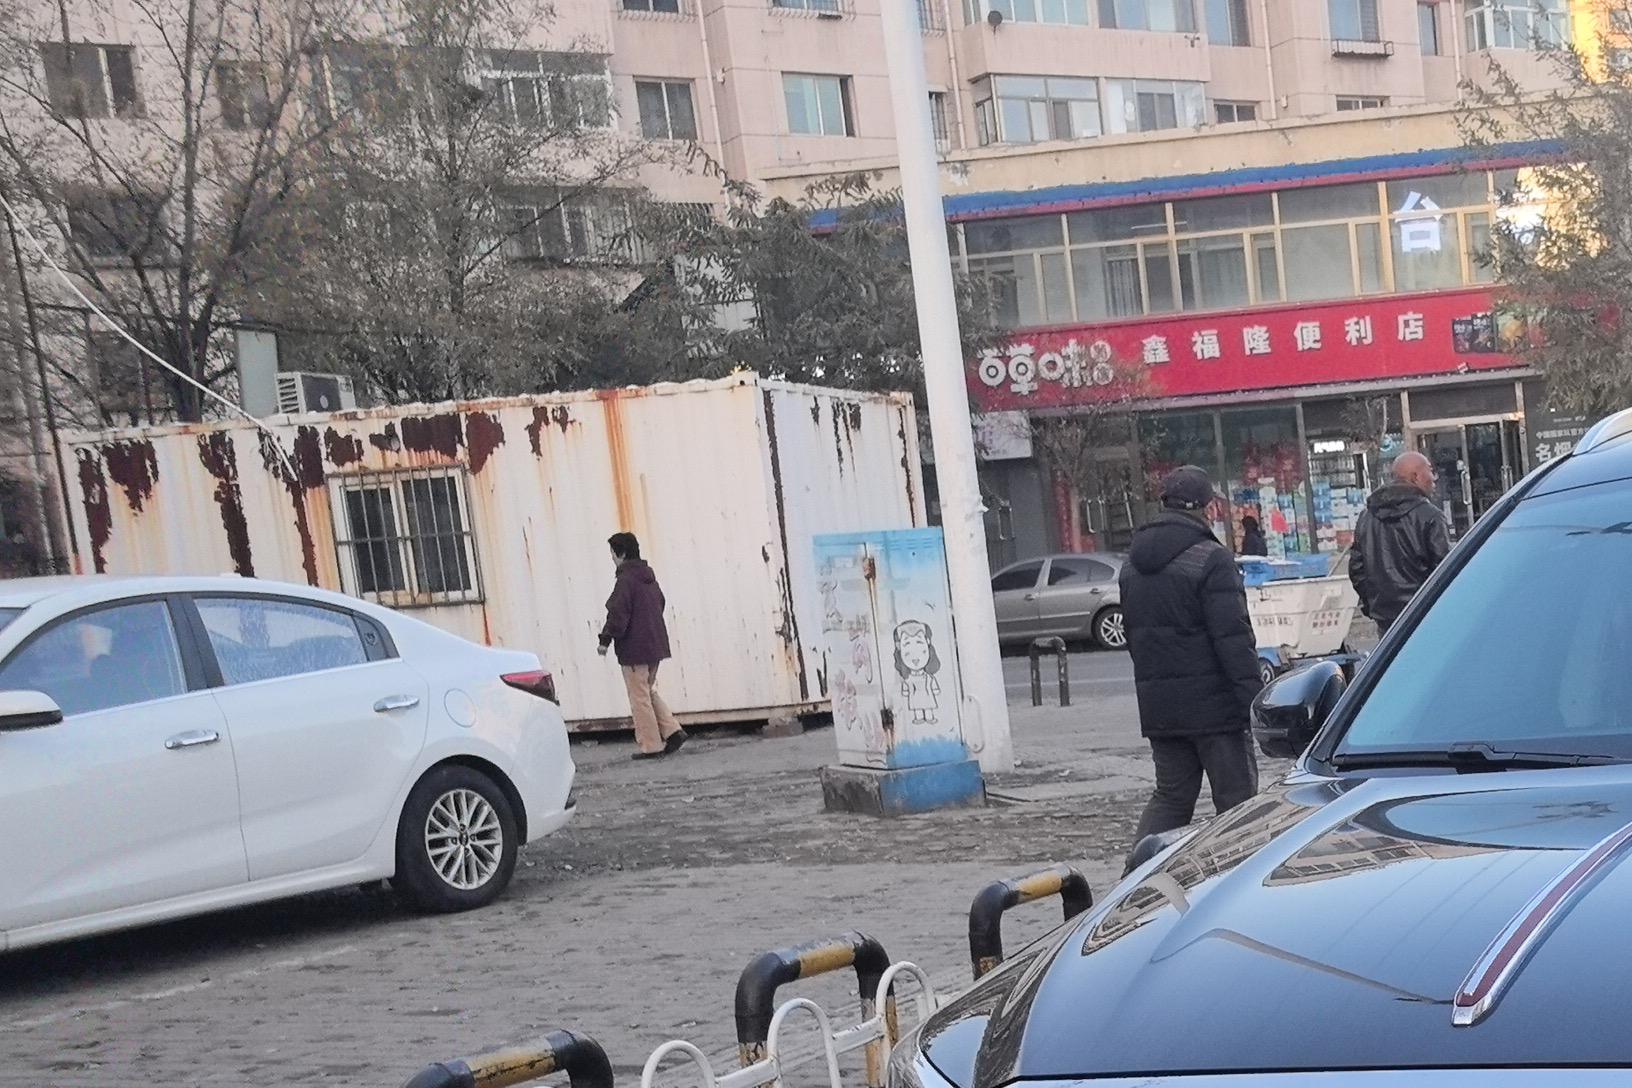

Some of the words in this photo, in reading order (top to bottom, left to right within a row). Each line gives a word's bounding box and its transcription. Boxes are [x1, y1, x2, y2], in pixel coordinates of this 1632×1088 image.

[1142, 310, 1425, 365] 鑫福隆便利店
[1535, 441, 1577, 462] 名烟
